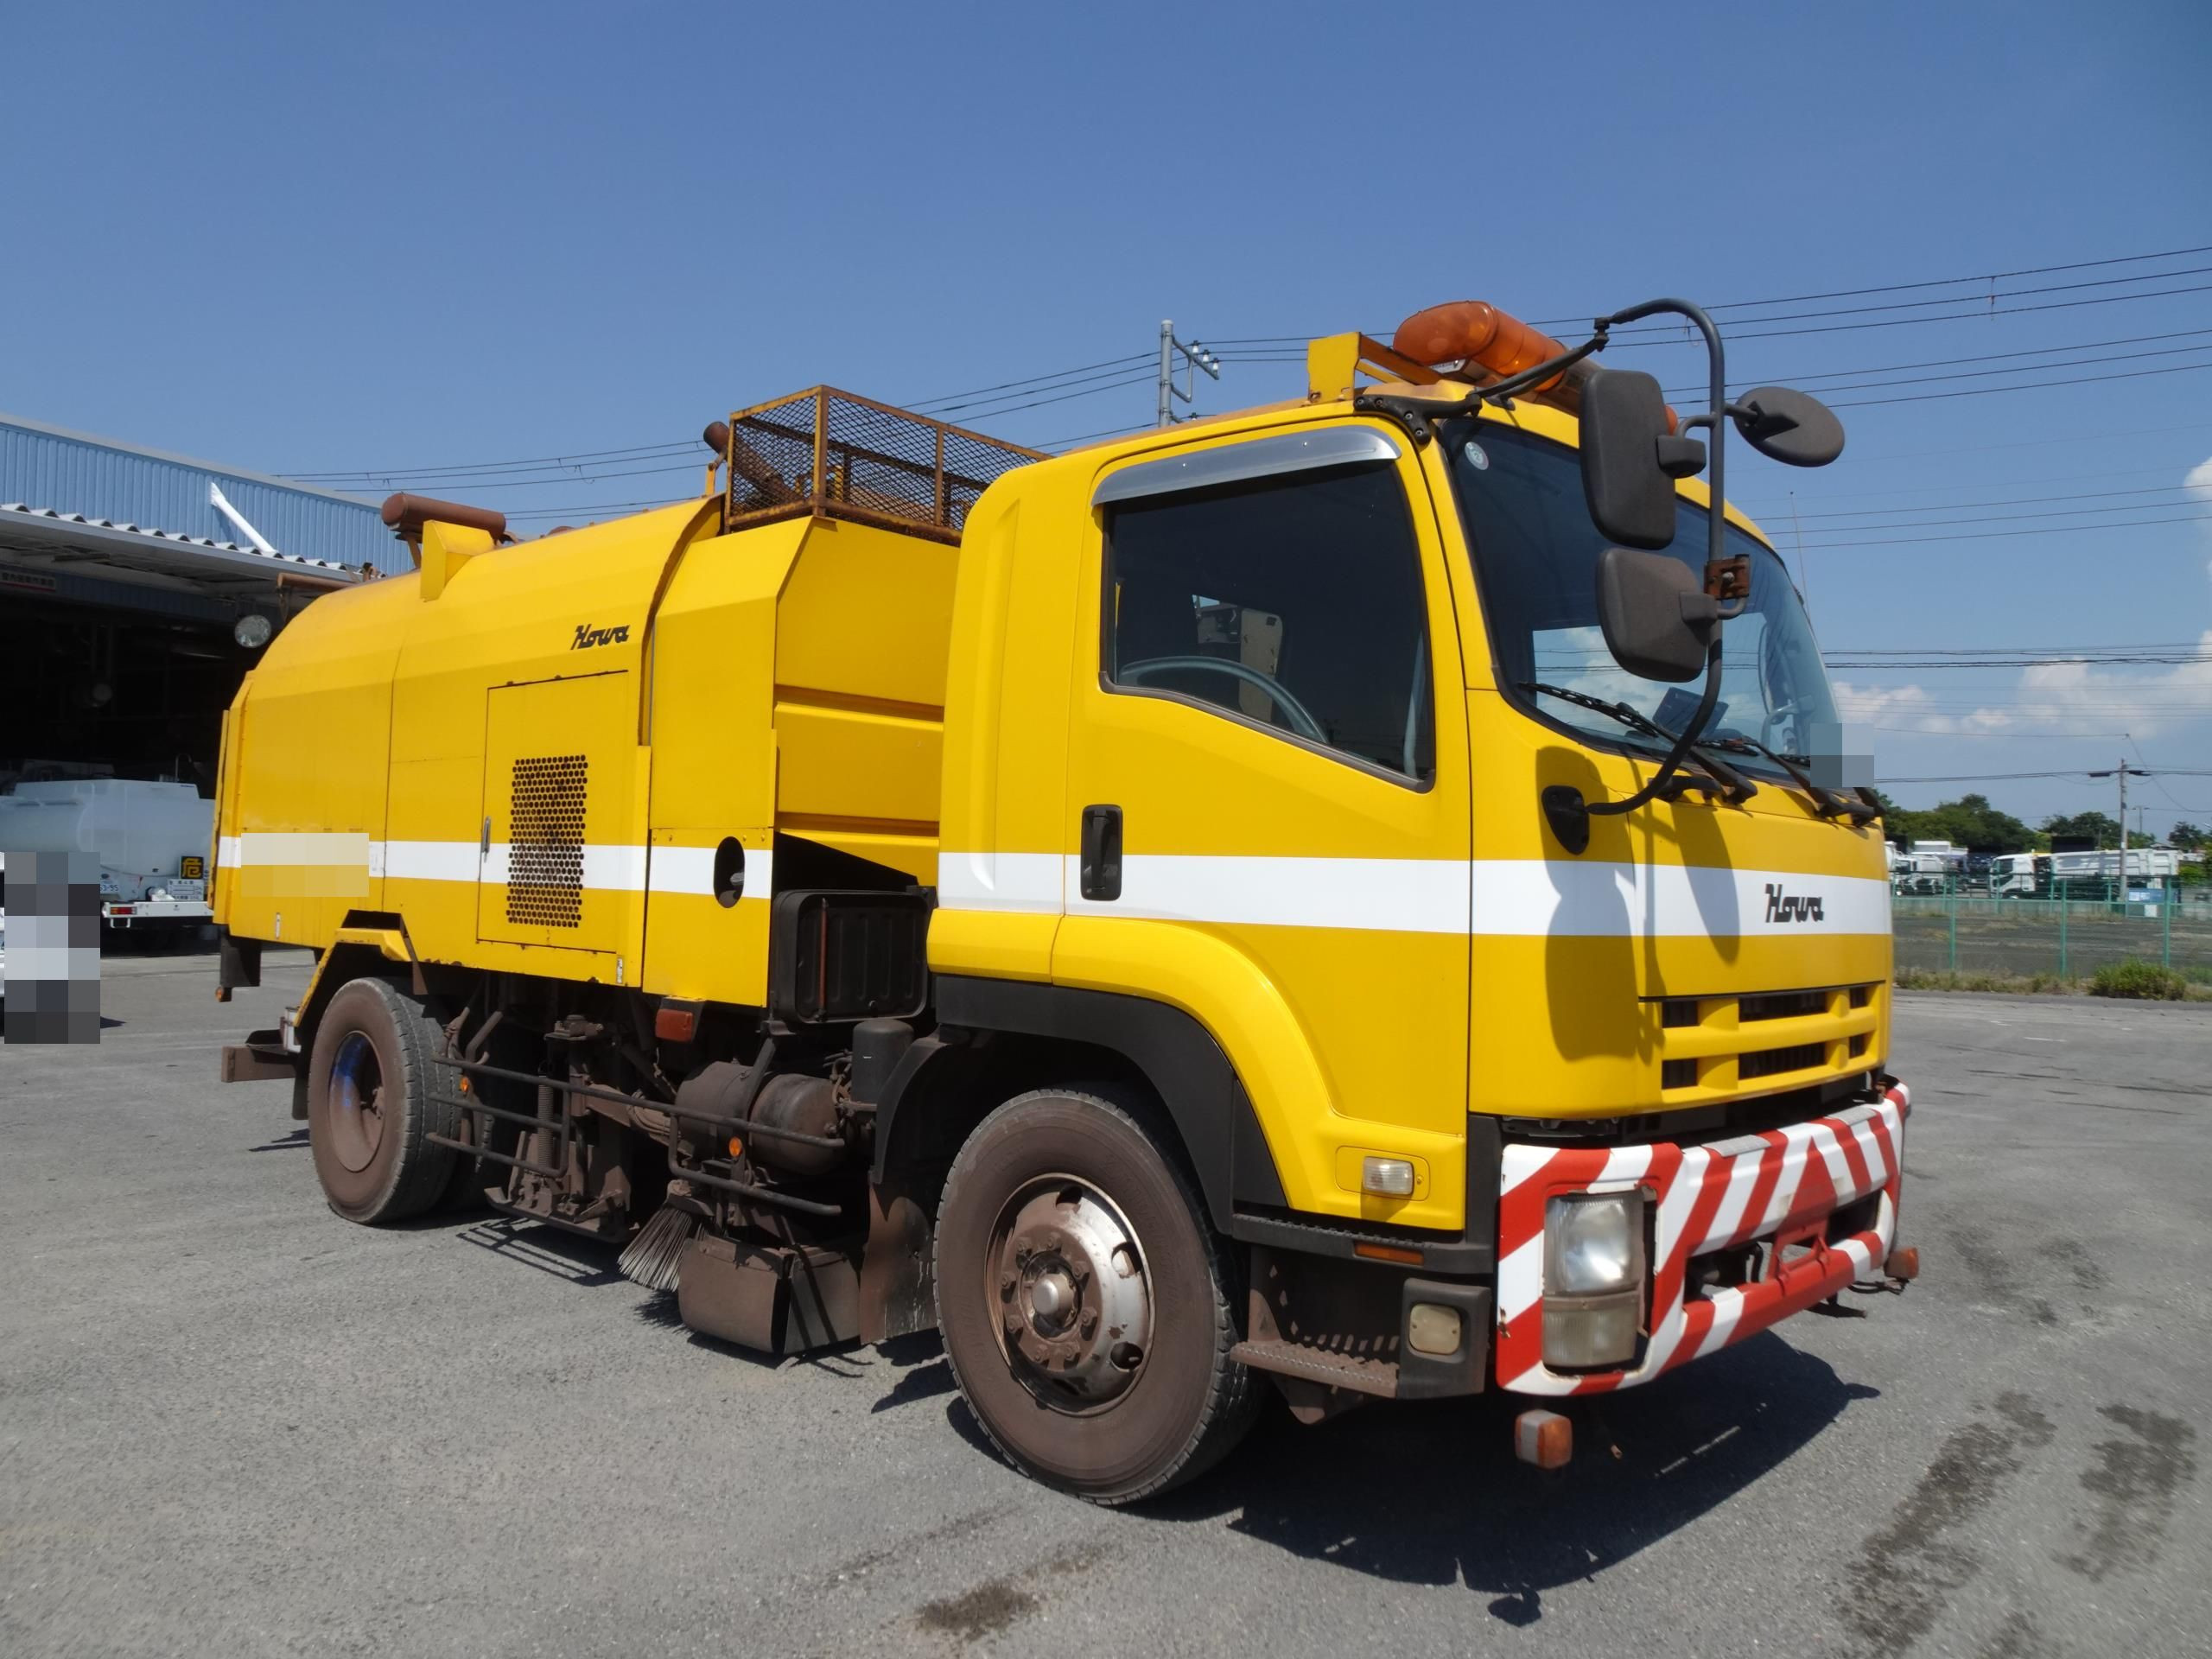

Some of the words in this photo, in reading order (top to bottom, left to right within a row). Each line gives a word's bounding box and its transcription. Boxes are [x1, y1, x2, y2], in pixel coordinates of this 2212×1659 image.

[570, 623, 629, 650] Howa
[182, 857, 202, 878] 危
[1764, 883, 1824, 923] Howa
